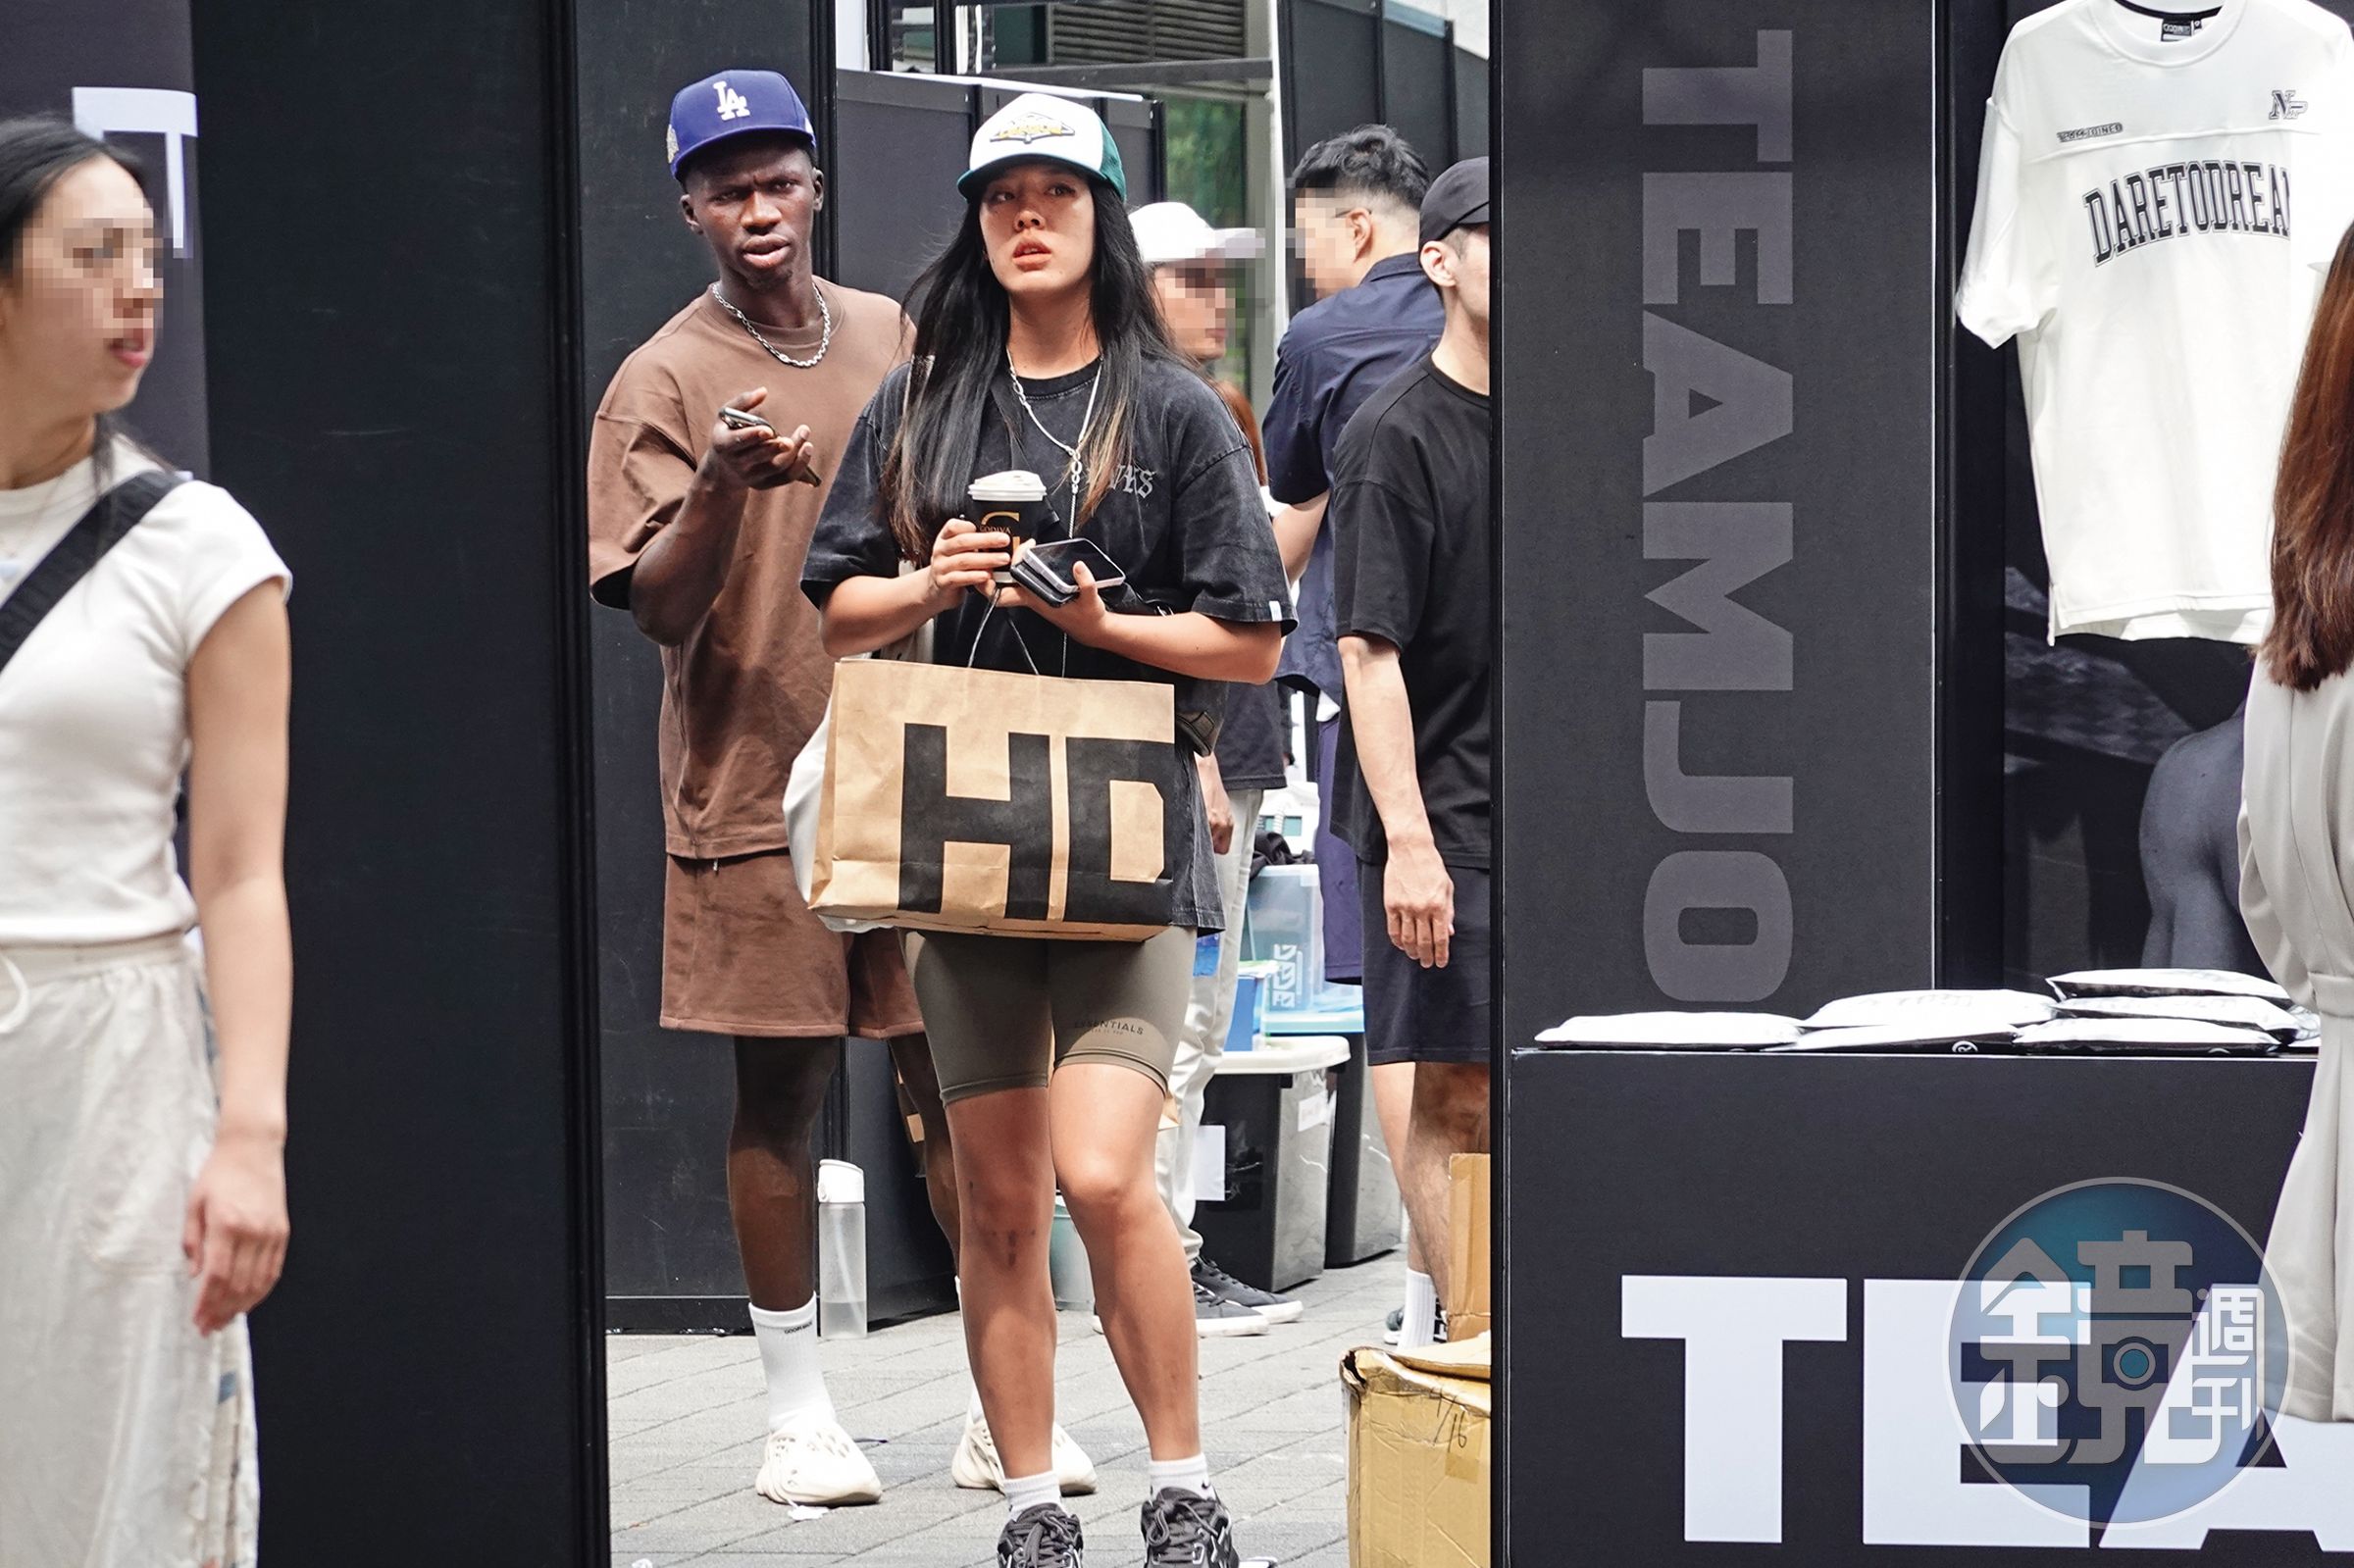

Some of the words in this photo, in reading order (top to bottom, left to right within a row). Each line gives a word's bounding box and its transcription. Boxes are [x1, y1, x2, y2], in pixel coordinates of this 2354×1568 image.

[713, 81, 750, 121] LA
[2082, 160, 2290, 268] DARETODREA
[1643, 29, 1794, 1002] TEAMJO
[1621, 1275, 2354, 1552] TEA
